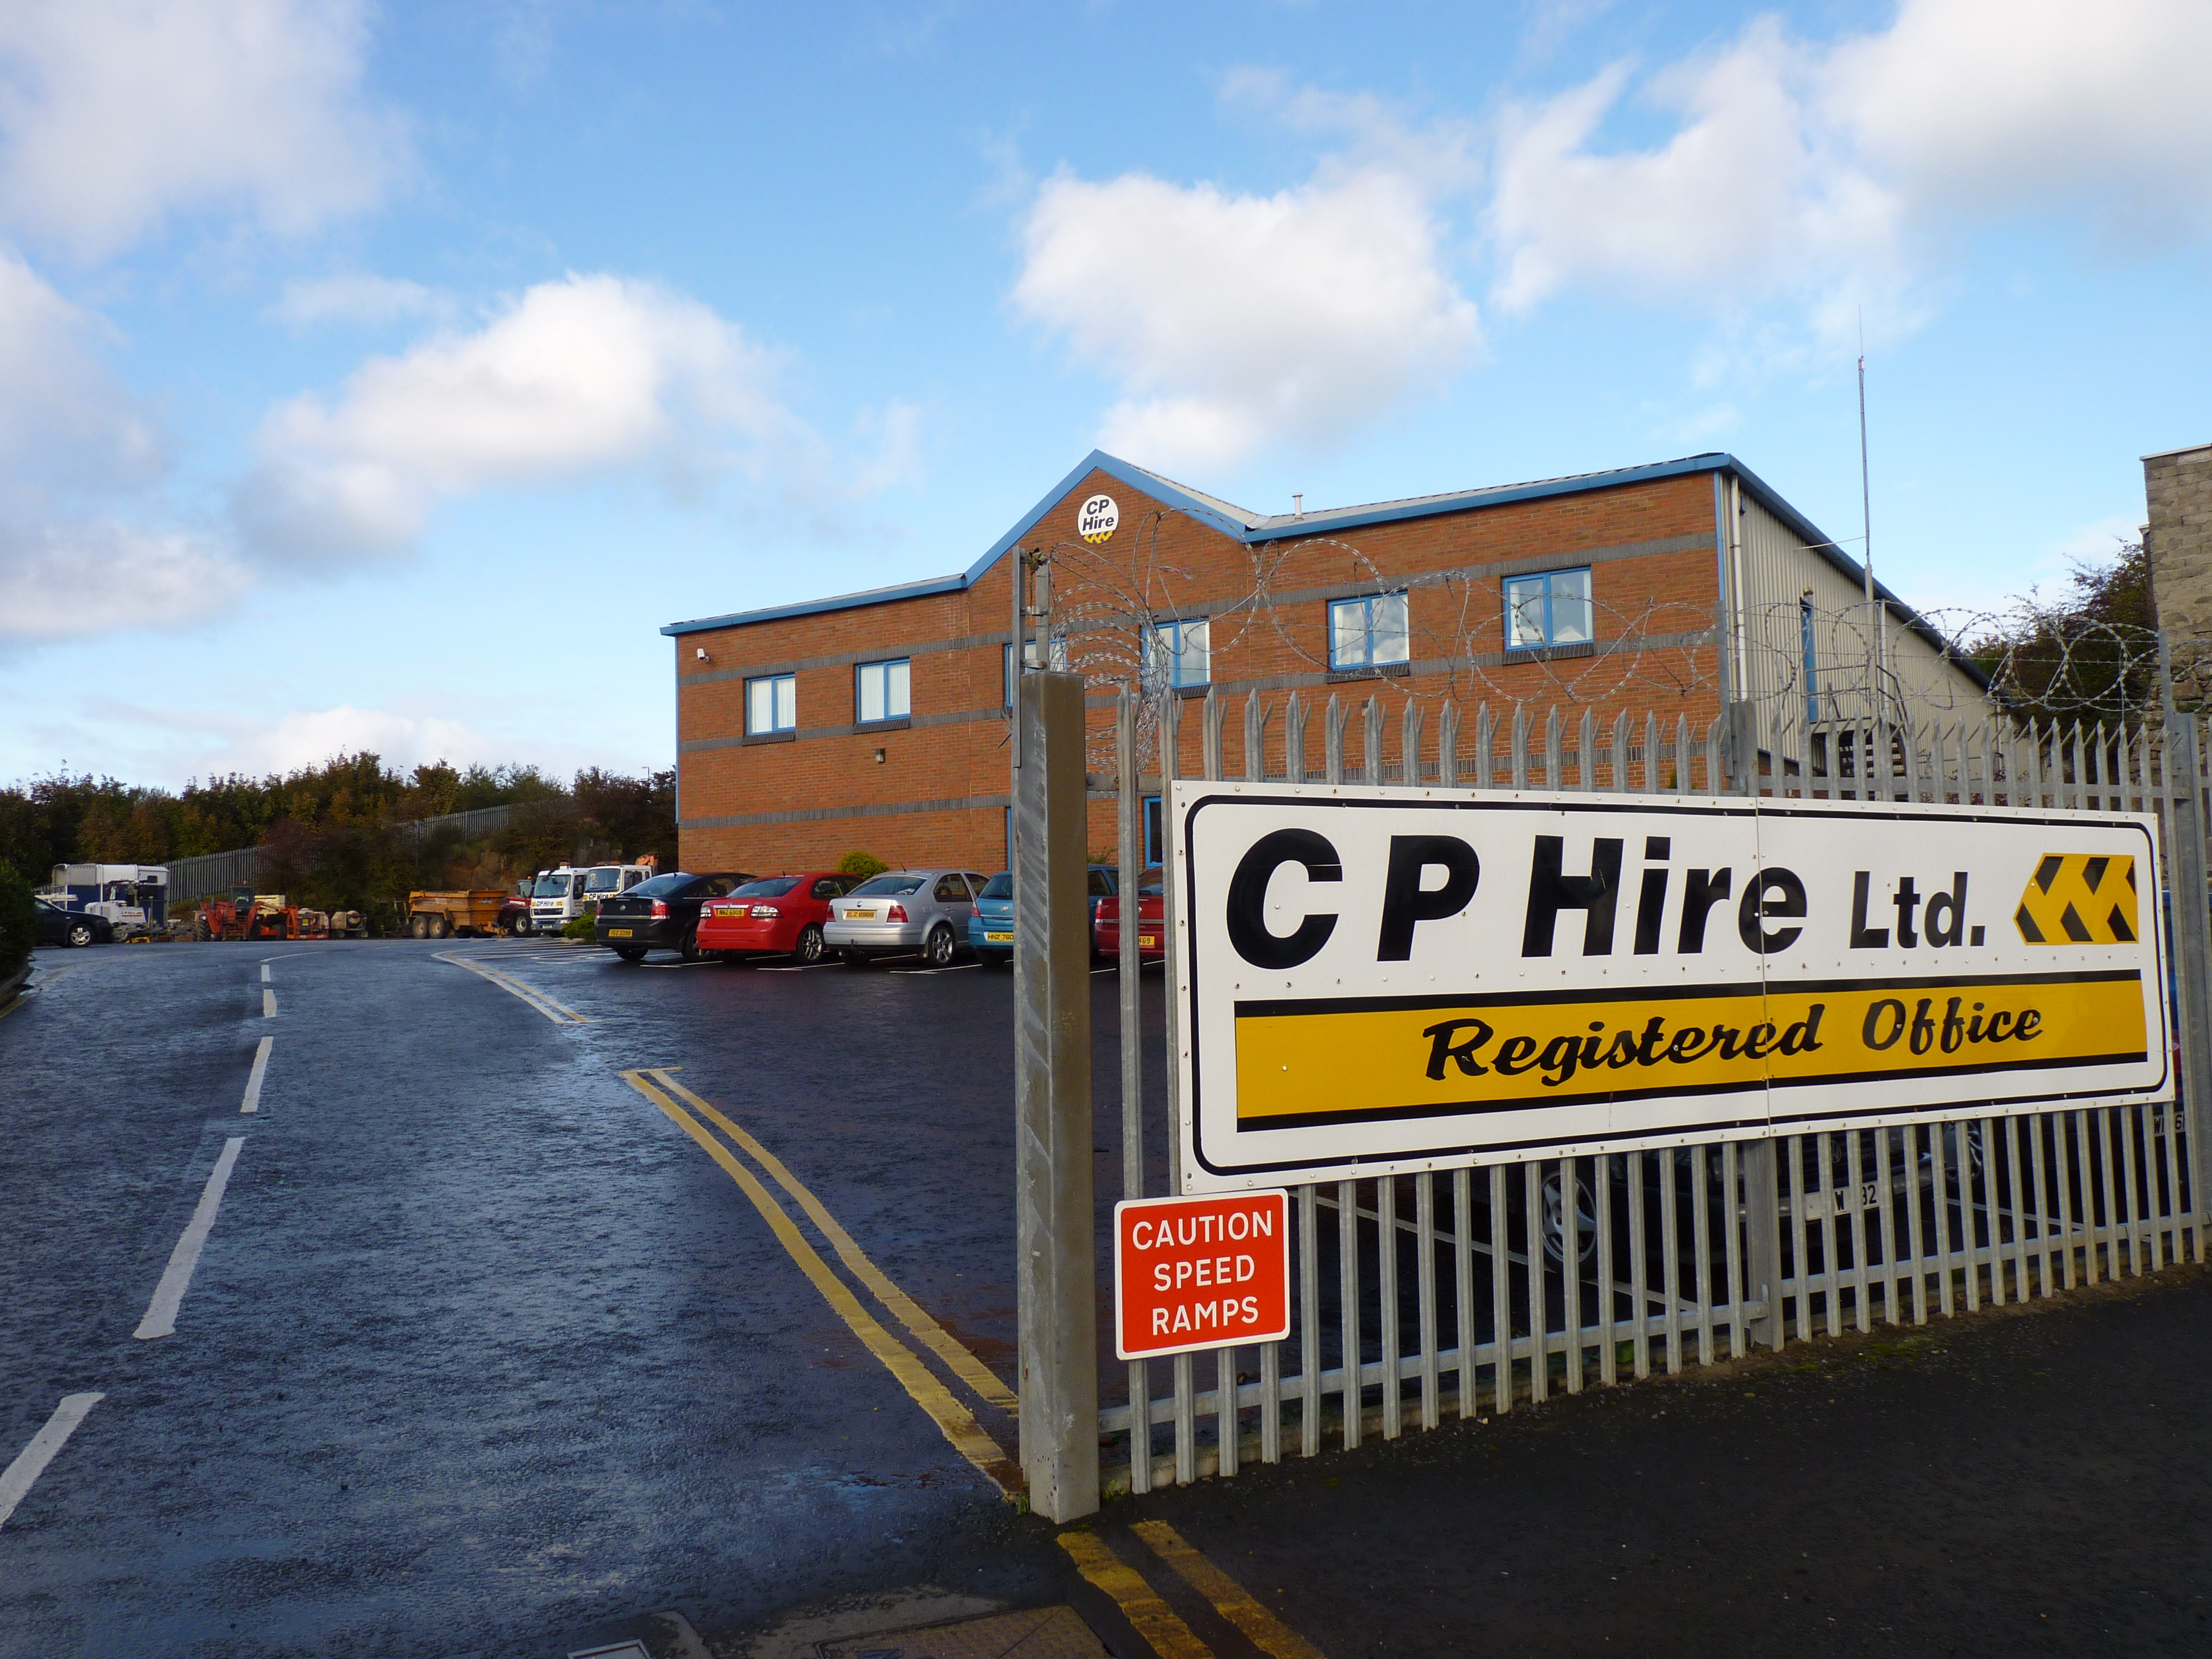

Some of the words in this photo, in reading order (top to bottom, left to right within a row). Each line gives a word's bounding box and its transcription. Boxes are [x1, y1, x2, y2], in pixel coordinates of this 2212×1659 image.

[1082, 516, 1114, 531] Hire
[1086, 499, 1109, 515] CP
[1521, 835, 1807, 955] Hire
[1850, 871, 1985, 949] Ltd.
[1422, 1004, 1824, 1087] Registered
[1863, 997, 2043, 1055] Office
[1133, 1210, 1272, 1250] CAUTION
[1154, 1255, 1255, 1291] SPEED
[1152, 1296, 1259, 1336] RAMPS
